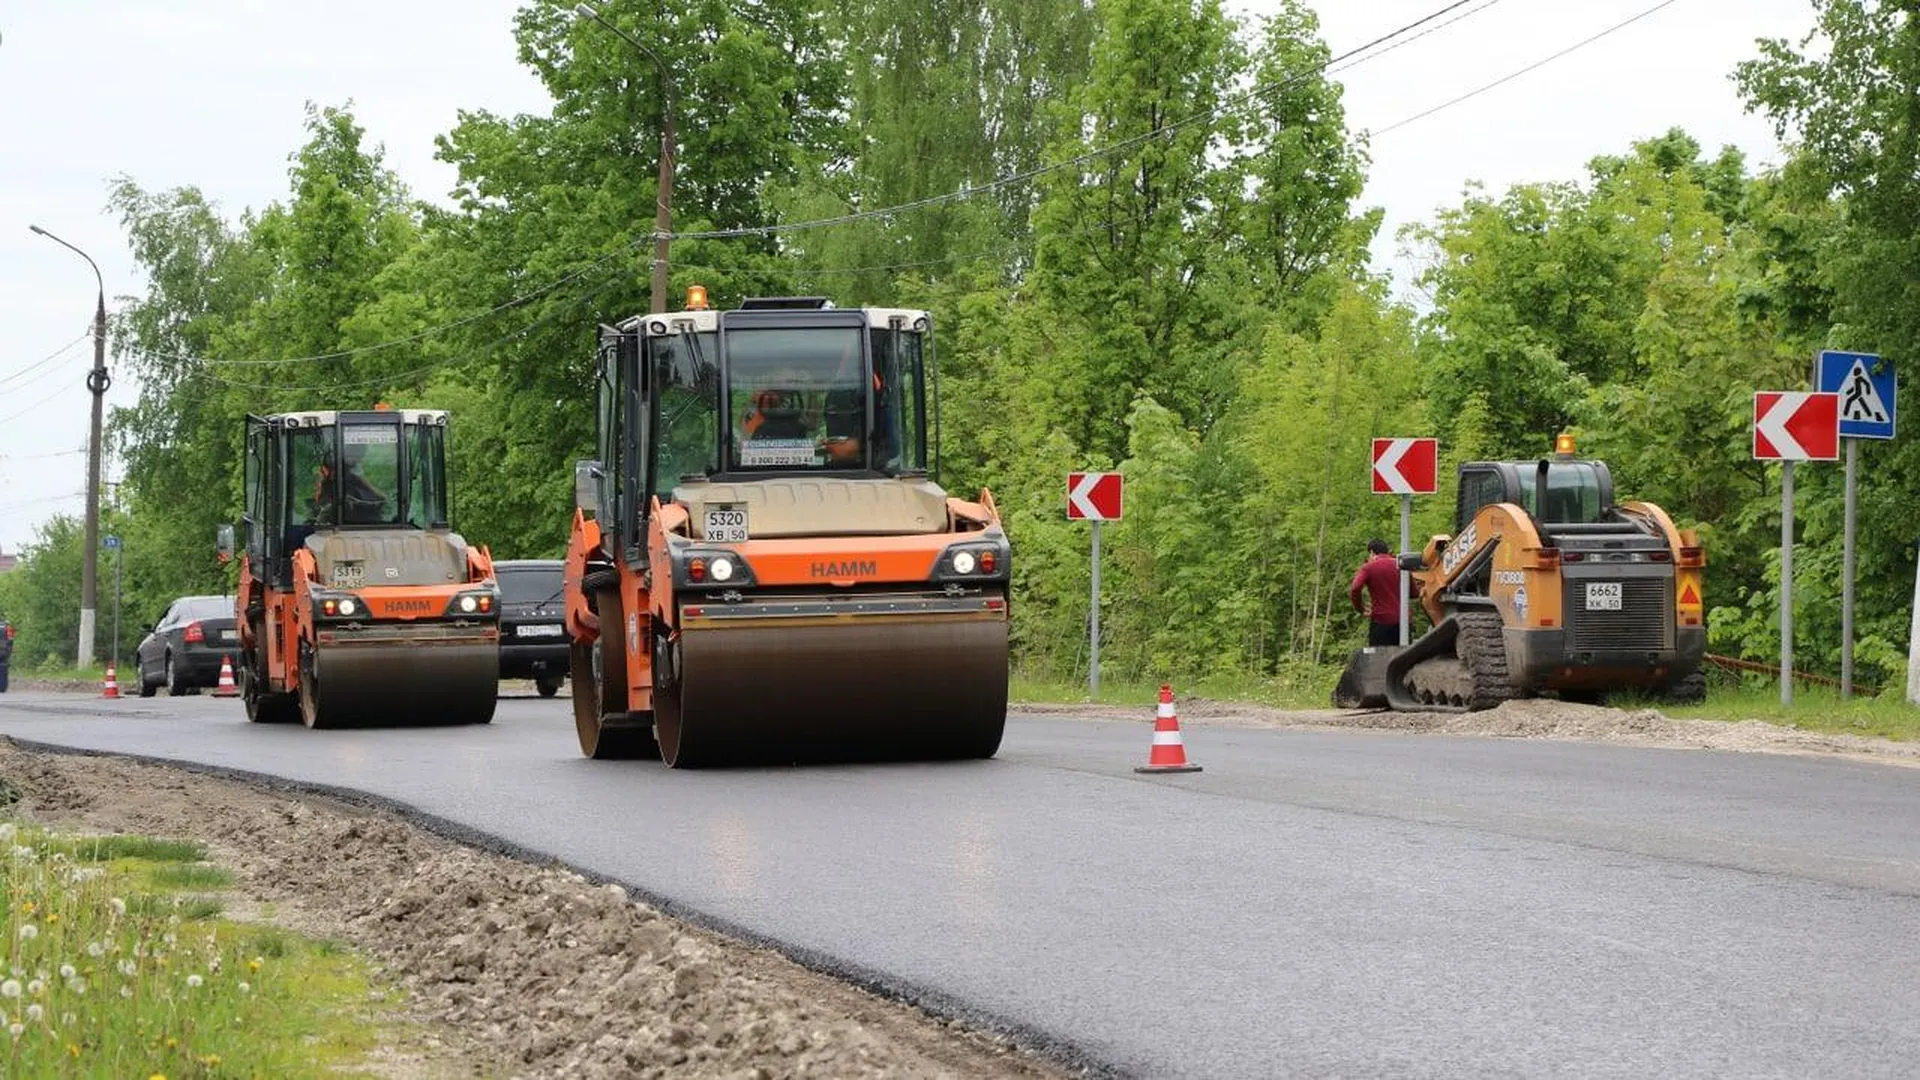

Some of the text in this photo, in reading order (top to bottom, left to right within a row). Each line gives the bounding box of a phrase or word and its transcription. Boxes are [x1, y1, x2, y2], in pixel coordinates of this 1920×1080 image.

[710, 512, 744, 526] 5320
[731, 529, 745, 540] 50
[1442, 523, 1477, 576] CASE
[338, 566, 361, 577] 5319
[811, 560, 877, 578] HAMM
[1590, 584, 1618, 597] 6662
[384, 601, 431, 612] HAMM
[1608, 599, 1620, 609] 50
